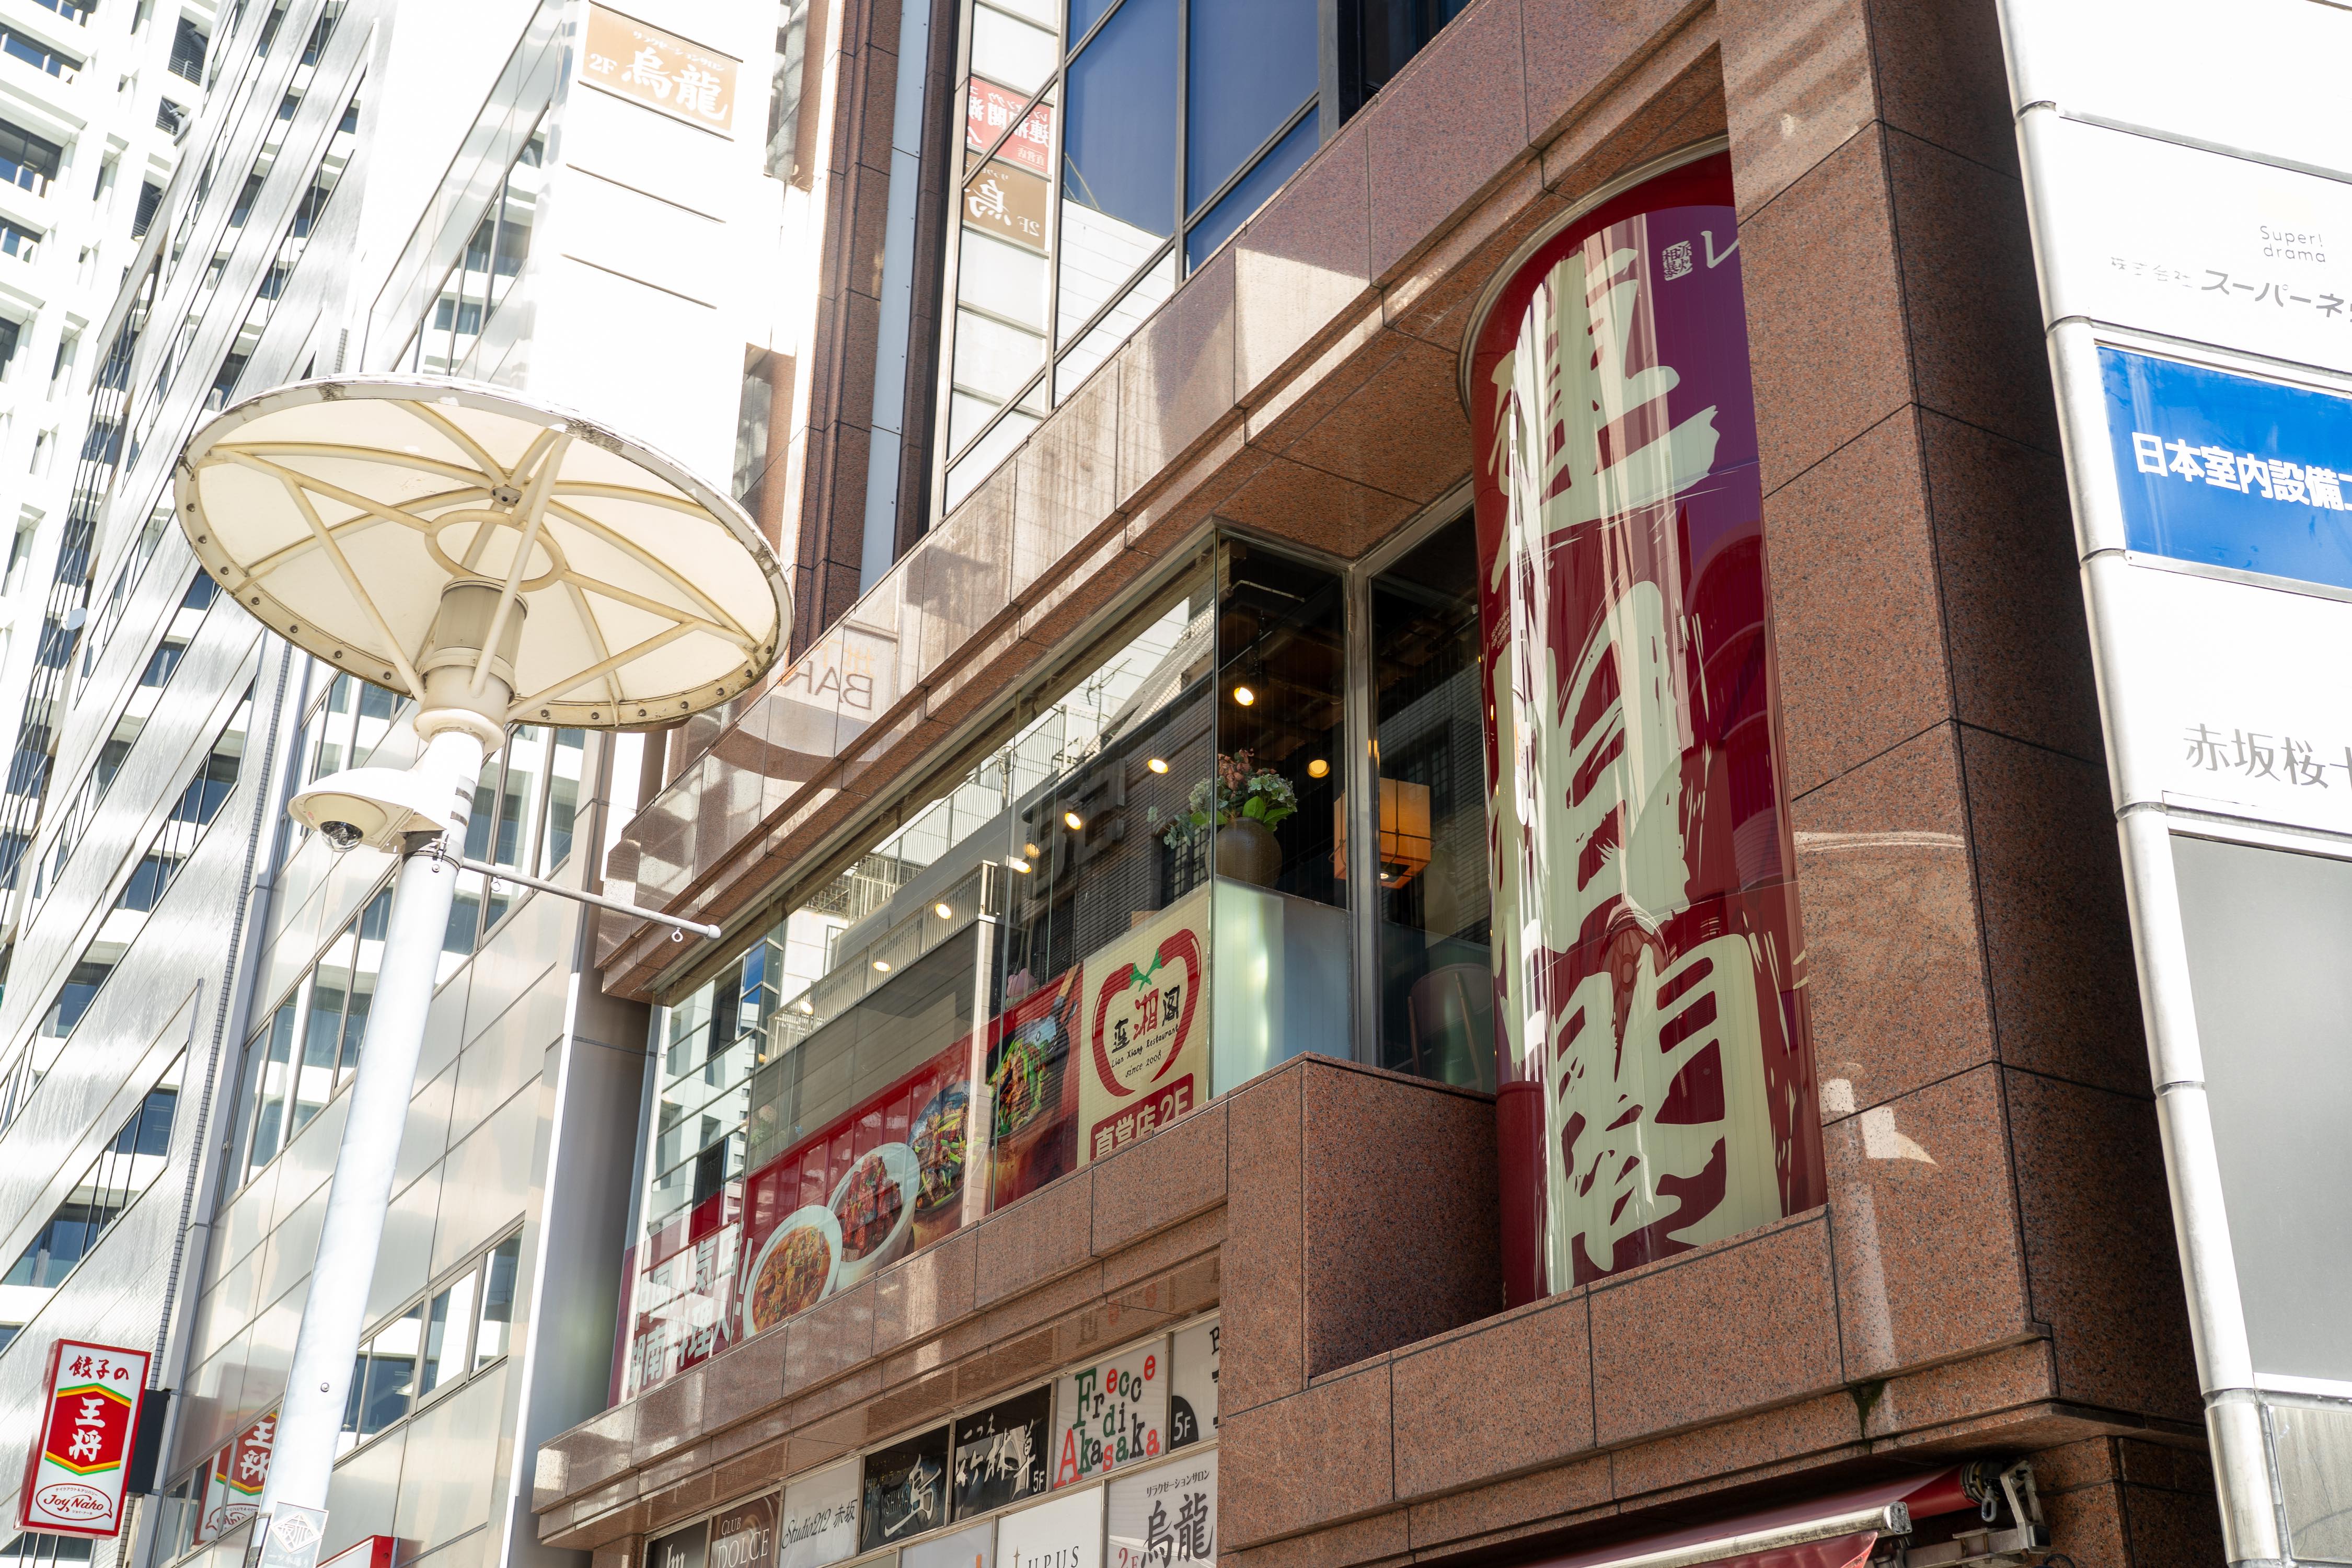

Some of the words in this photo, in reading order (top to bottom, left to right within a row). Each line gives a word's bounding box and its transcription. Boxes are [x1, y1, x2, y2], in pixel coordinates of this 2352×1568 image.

[589, 53, 618, 75] 2F
[2259, 225, 2324, 247] Super!
[2263, 244, 2326, 263] drama
[2201, 269, 2352, 323] スーパーネ
[1112, 1056, 1124, 1068] Lian
[1127, 1045, 1143, 1059] Xiang
[1146, 1023, 1179, 1048] Restaurant
[1125, 1063, 1143, 1078] since
[1145, 1050, 1162, 1067] 2008
[68, 1355, 129, 1380] 餃子の
[1073, 1355, 1156, 1430] Frecce
[68, 1396, 106, 1462] 王将
[1103, 1401, 1126, 1437] di
[1173, 1411, 1191, 1441] 5F
[1054, 1428, 1160, 1489] Akasaka
[1033, 1470, 1045, 1492] 5F
[1147, 1470, 1210, 1497] リラクゼーションサロン
[71, 1494, 104, 1511] Naho
[721, 1517, 741, 1536] CLUB
[781, 1508, 831, 1549] Studio212
[833, 1498, 858, 1528] 赤坂
[718, 1528, 770, 1568] DOLCE
[1119, 1547, 1139, 1568] 2F
